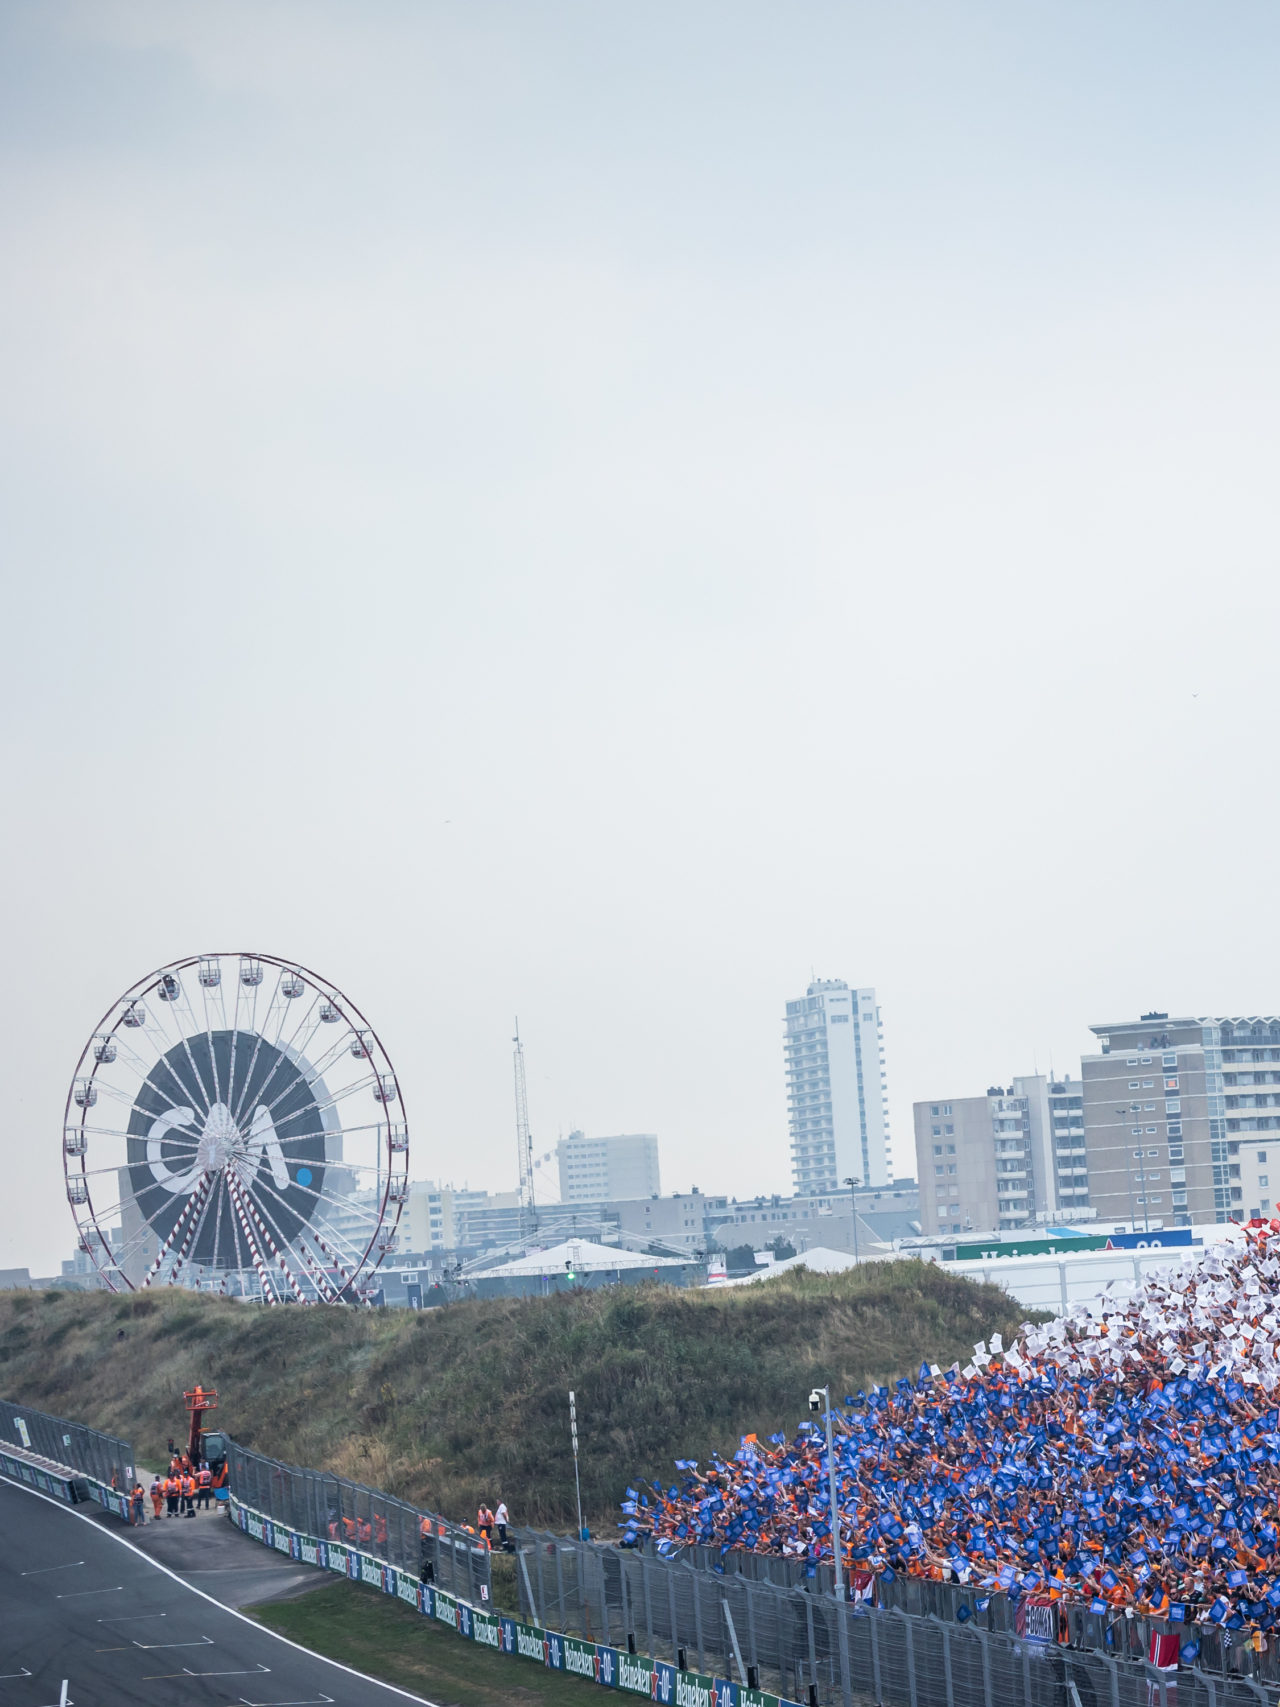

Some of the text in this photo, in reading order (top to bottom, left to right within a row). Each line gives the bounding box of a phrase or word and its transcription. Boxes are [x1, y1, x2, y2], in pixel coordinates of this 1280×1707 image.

[517, 1626, 544, 1661] Heineken
[564, 1640, 594, 1677] Heineken
[619, 1656, 650, 1693] Heineken
[676, 1673, 709, 1707] Heineken
